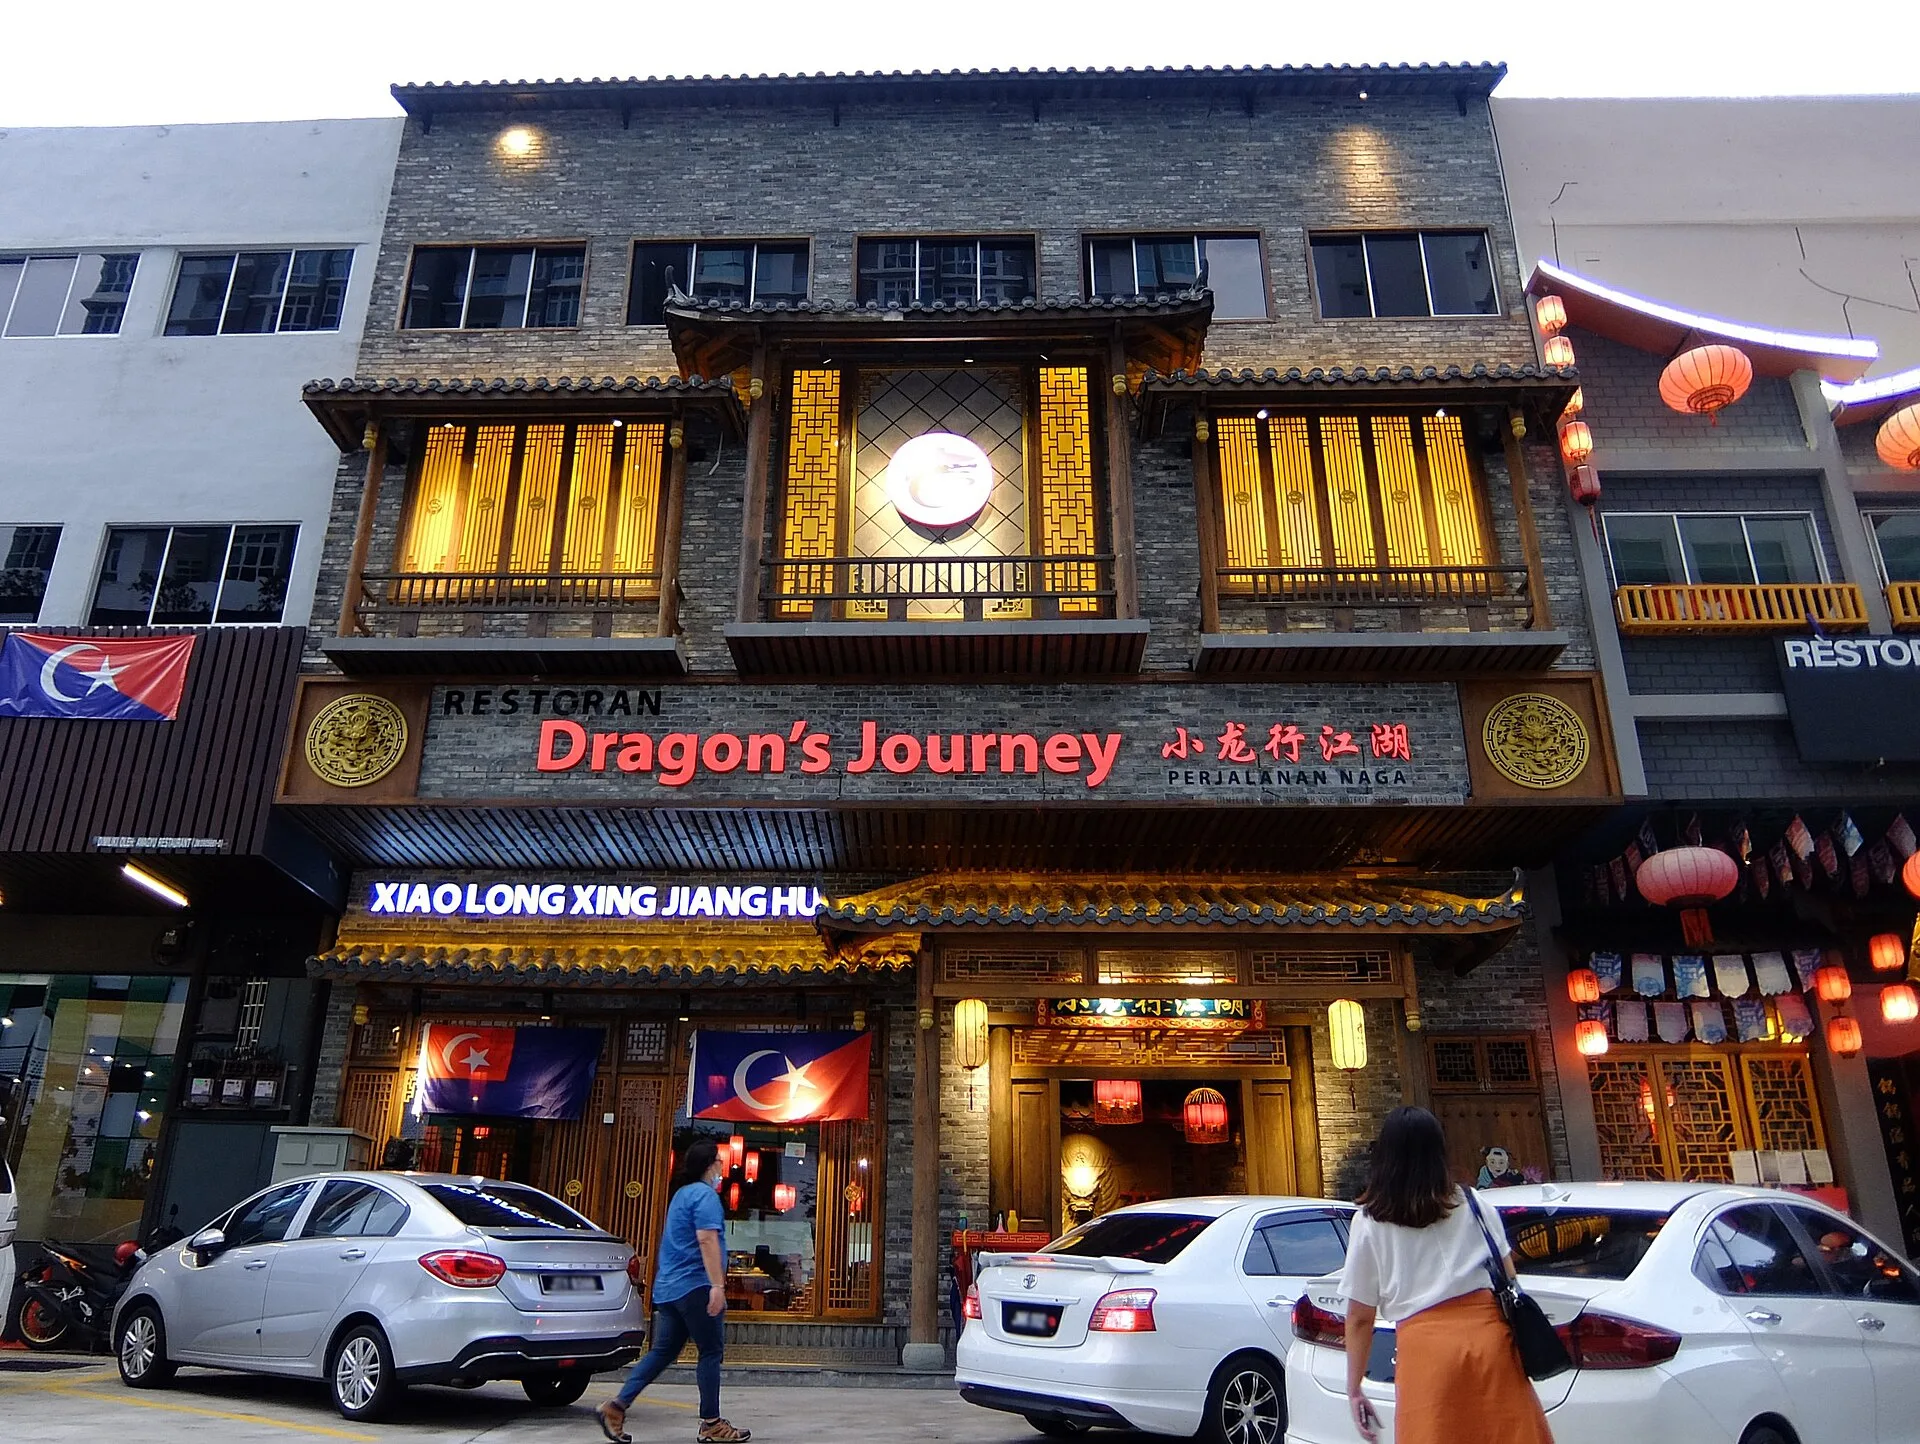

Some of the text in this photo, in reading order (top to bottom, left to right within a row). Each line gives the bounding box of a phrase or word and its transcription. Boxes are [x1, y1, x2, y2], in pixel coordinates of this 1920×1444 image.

[443, 689, 662, 716] RESTORAN
[536, 719, 1122, 787] Dragon's Journey
[1161, 721, 1411, 763] 小龙行江湖
[1168, 769, 1407, 786] PERJALANAN NAGA
[370, 882, 824, 917] XIAO LONG XING JIANG HU
